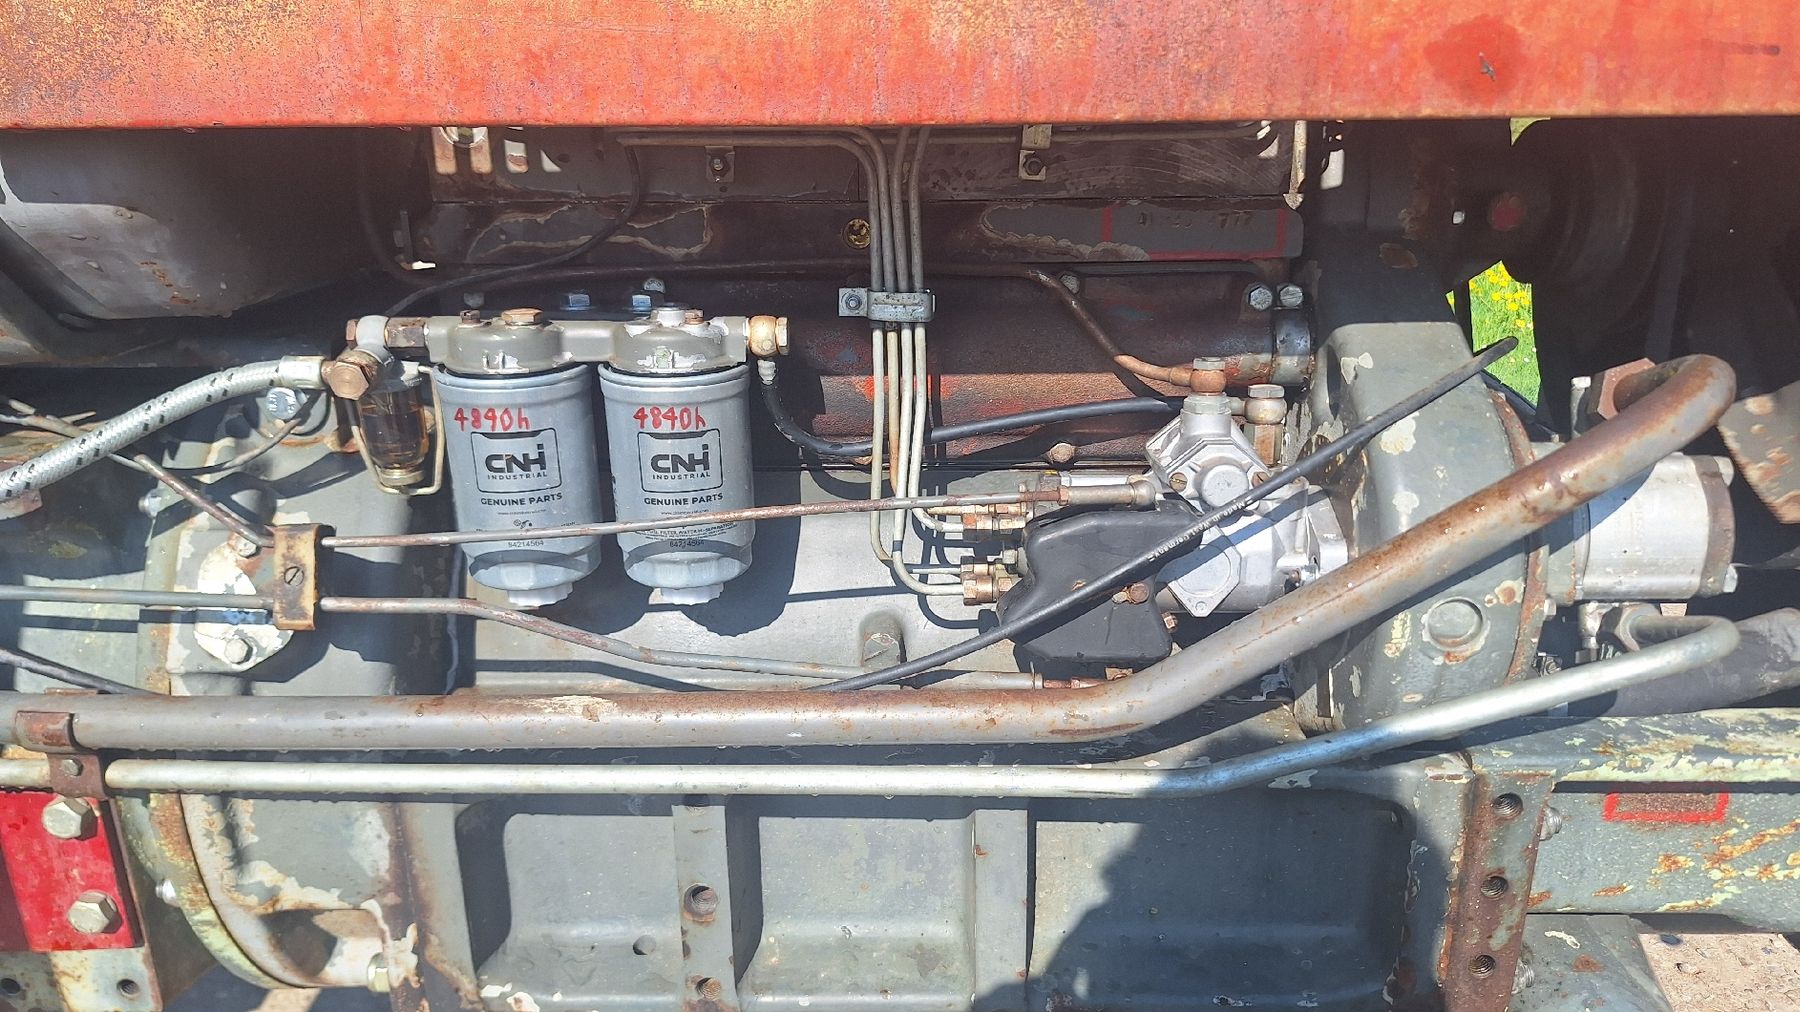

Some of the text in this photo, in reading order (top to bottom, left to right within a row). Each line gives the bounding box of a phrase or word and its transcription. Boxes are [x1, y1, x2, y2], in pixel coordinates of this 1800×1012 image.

[633, 406, 707, 430] 4840h
[487, 472, 548, 480] INDUSTRIAL
[652, 472, 711, 480] INDUSTRIAL
[481, 492, 563, 506] GENUINE PARTS
[644, 492, 723, 506] GENUINE PARTS
